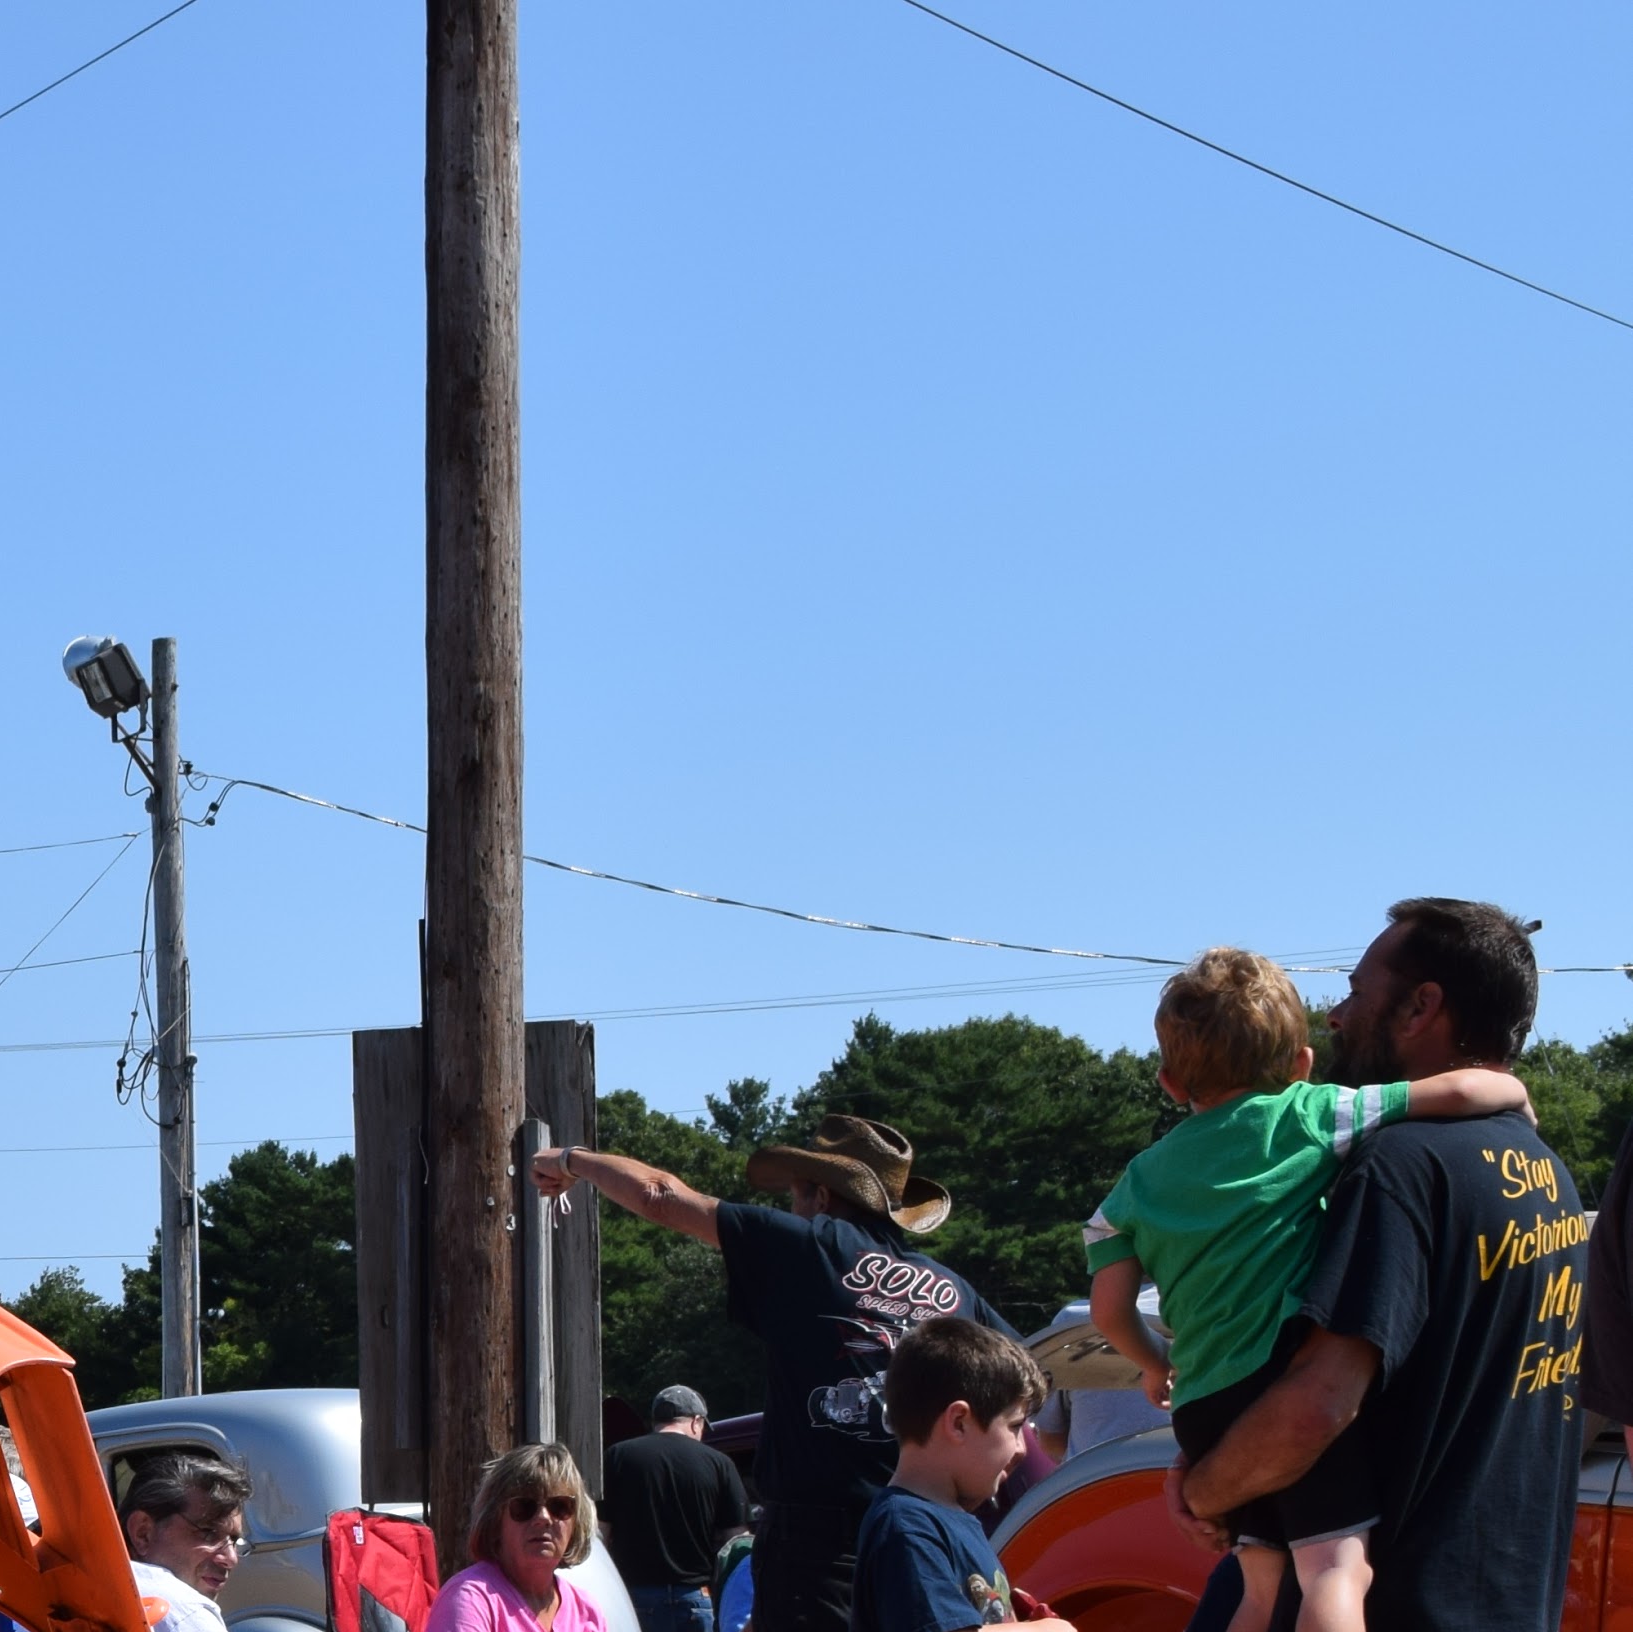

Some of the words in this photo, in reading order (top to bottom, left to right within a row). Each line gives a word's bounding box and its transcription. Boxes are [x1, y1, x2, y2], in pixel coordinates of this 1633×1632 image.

[842, 1252, 960, 1314] SOLO
[856, 1294, 910, 1316] SPEED
[1538, 1265, 1583, 1330] My
